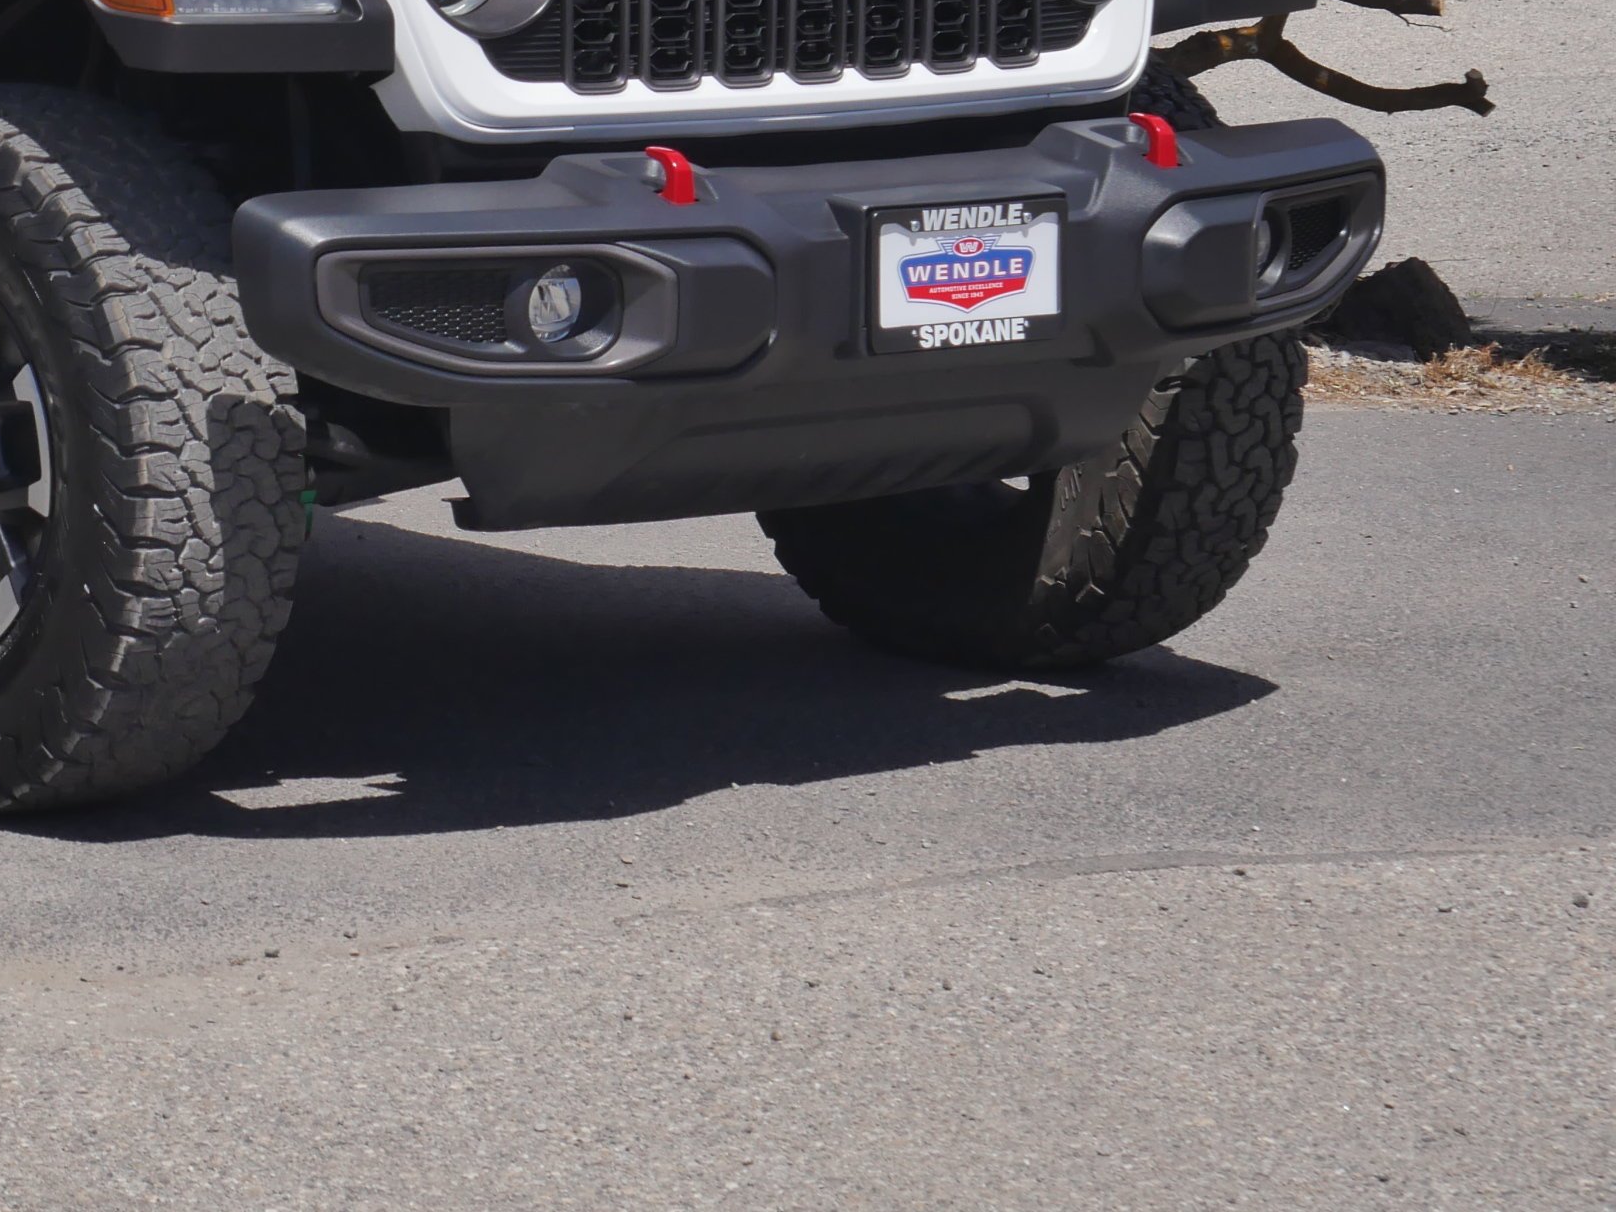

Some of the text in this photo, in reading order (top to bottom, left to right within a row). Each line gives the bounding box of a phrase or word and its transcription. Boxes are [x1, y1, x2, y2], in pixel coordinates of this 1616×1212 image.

[922, 203, 1024, 231] WENDLE
[908, 258, 1023, 283] WENDLE
[929, 282, 1004, 293] AUTOMOTIVE EXCELLENCE
[918, 318, 1026, 349] SPOKANE
